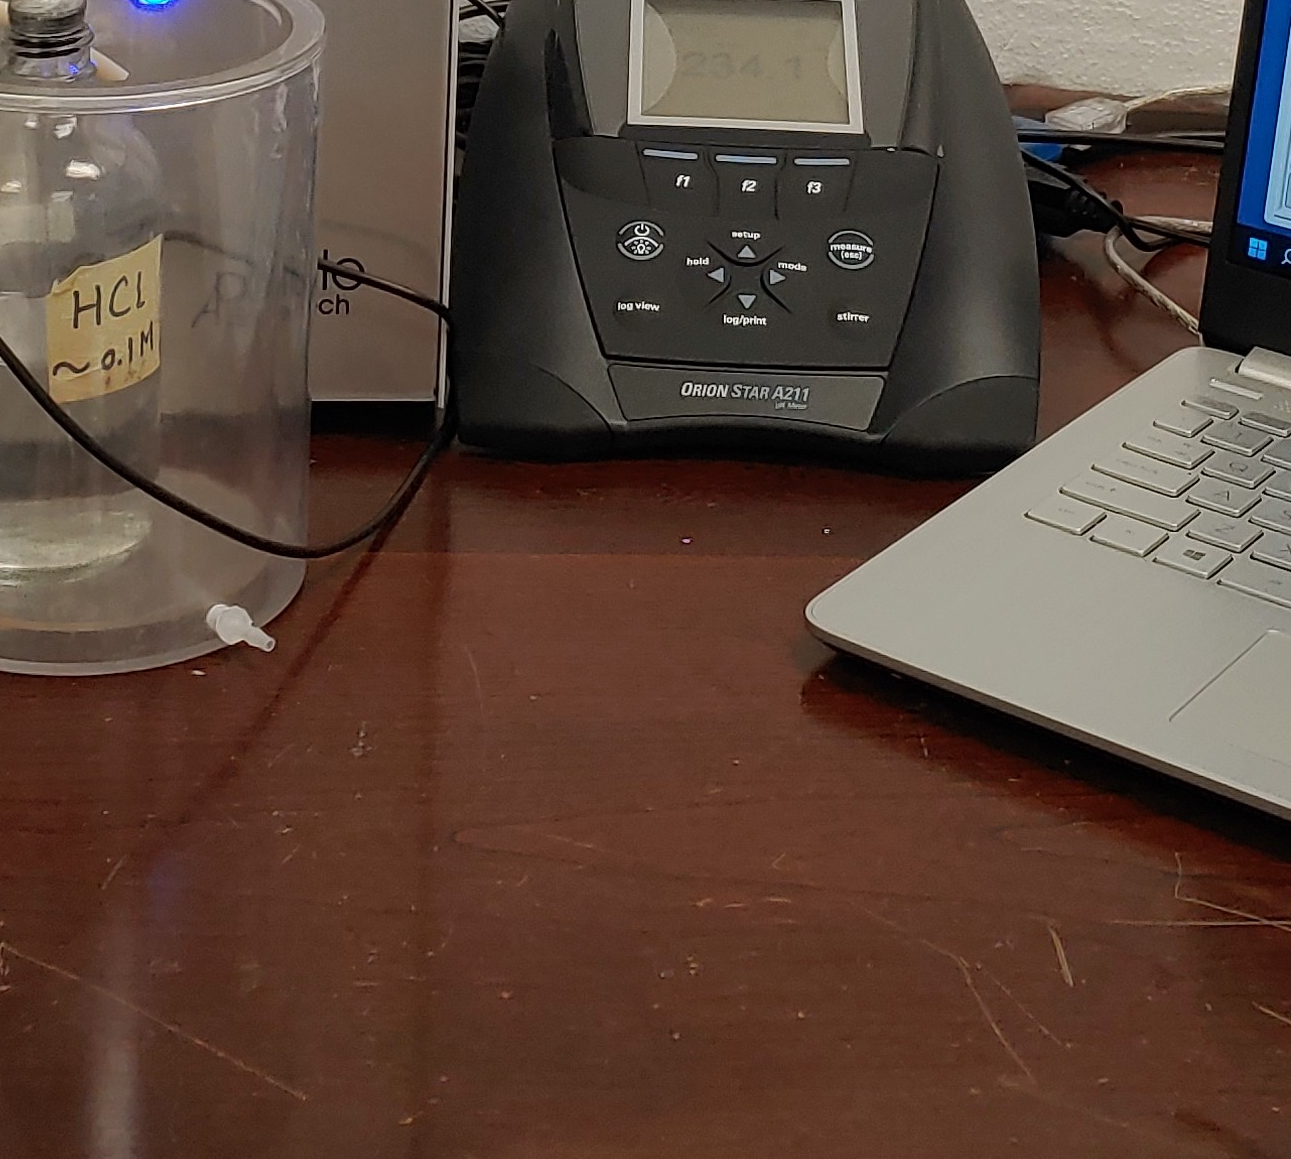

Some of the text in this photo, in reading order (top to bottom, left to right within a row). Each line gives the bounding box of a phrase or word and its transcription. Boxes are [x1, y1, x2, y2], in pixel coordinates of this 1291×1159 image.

[676, 174, 691, 188] f1
[741, 179, 757, 192] f2
[806, 180, 822, 194] f3
[731, 230, 761, 240] setup
[830, 243, 873, 254] measure
[841, 250, 863, 261] (esc)
[685, 257, 709, 266] hold
[777, 261, 807, 272] mode
[71, 273, 146, 330] HCl
[617, 301, 660, 312] log view
[723, 314, 767, 326] log/print
[837, 312, 869, 323] stirrer
[681, 382, 810, 402] ORION STAR A211
